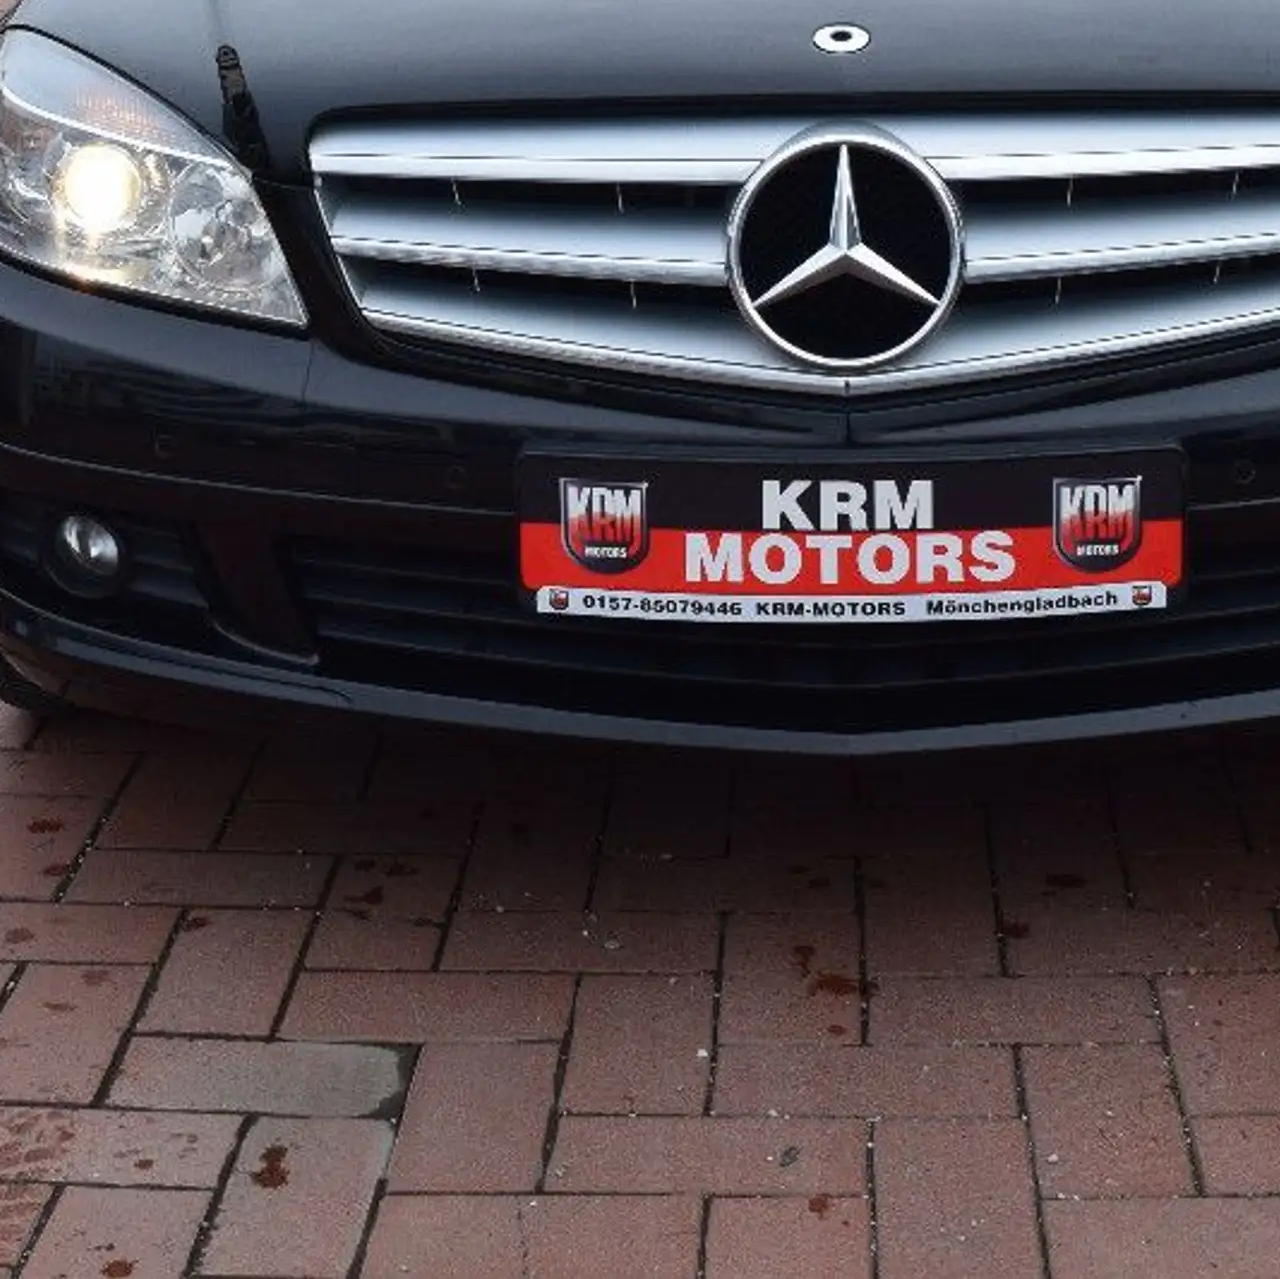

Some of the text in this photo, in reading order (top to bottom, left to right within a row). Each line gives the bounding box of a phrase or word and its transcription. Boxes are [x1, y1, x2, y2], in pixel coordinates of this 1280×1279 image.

[762, 480, 934, 531] KRM
[685, 530, 1017, 584] MOTORS
[756, 601, 906, 616] KRM-MOTORS
[926, 590, 1118, 615] Mönchengladbach
